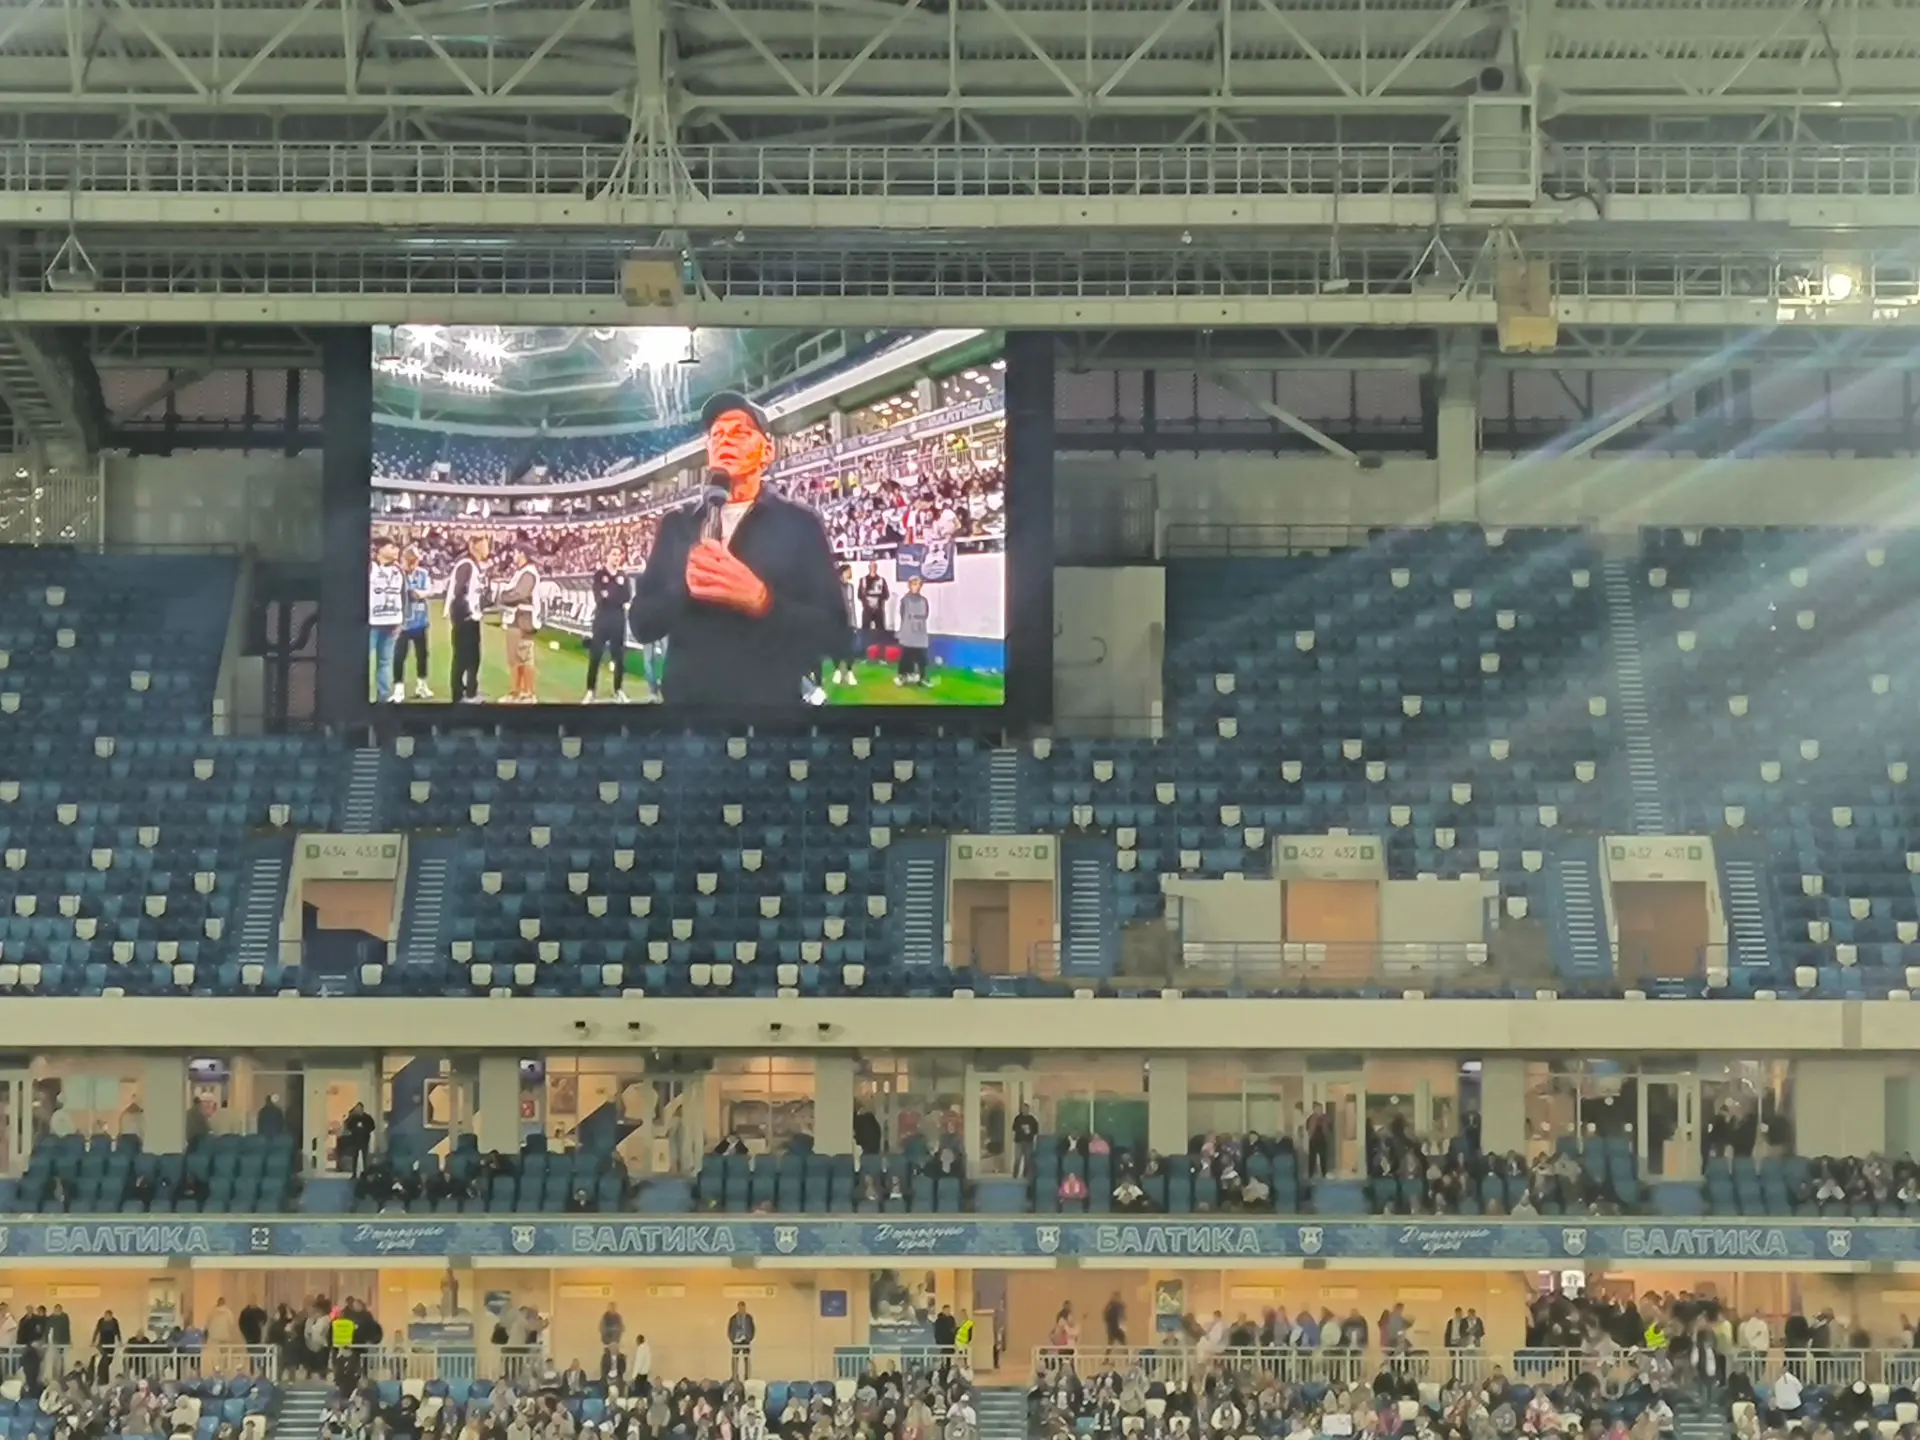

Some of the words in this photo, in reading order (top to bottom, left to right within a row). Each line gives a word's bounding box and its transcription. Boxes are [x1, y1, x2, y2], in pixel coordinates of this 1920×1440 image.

[975, 846, 999, 859] 433
[1008, 846, 1032, 859] 432
[45, 1226, 210, 1253] БАЛТИКА
[572, 1226, 736, 1253] БАЛТИКА
[1096, 1226, 1262, 1254] БАЛТИКА
[1622, 1228, 1788, 1256] БАЛТИКА
